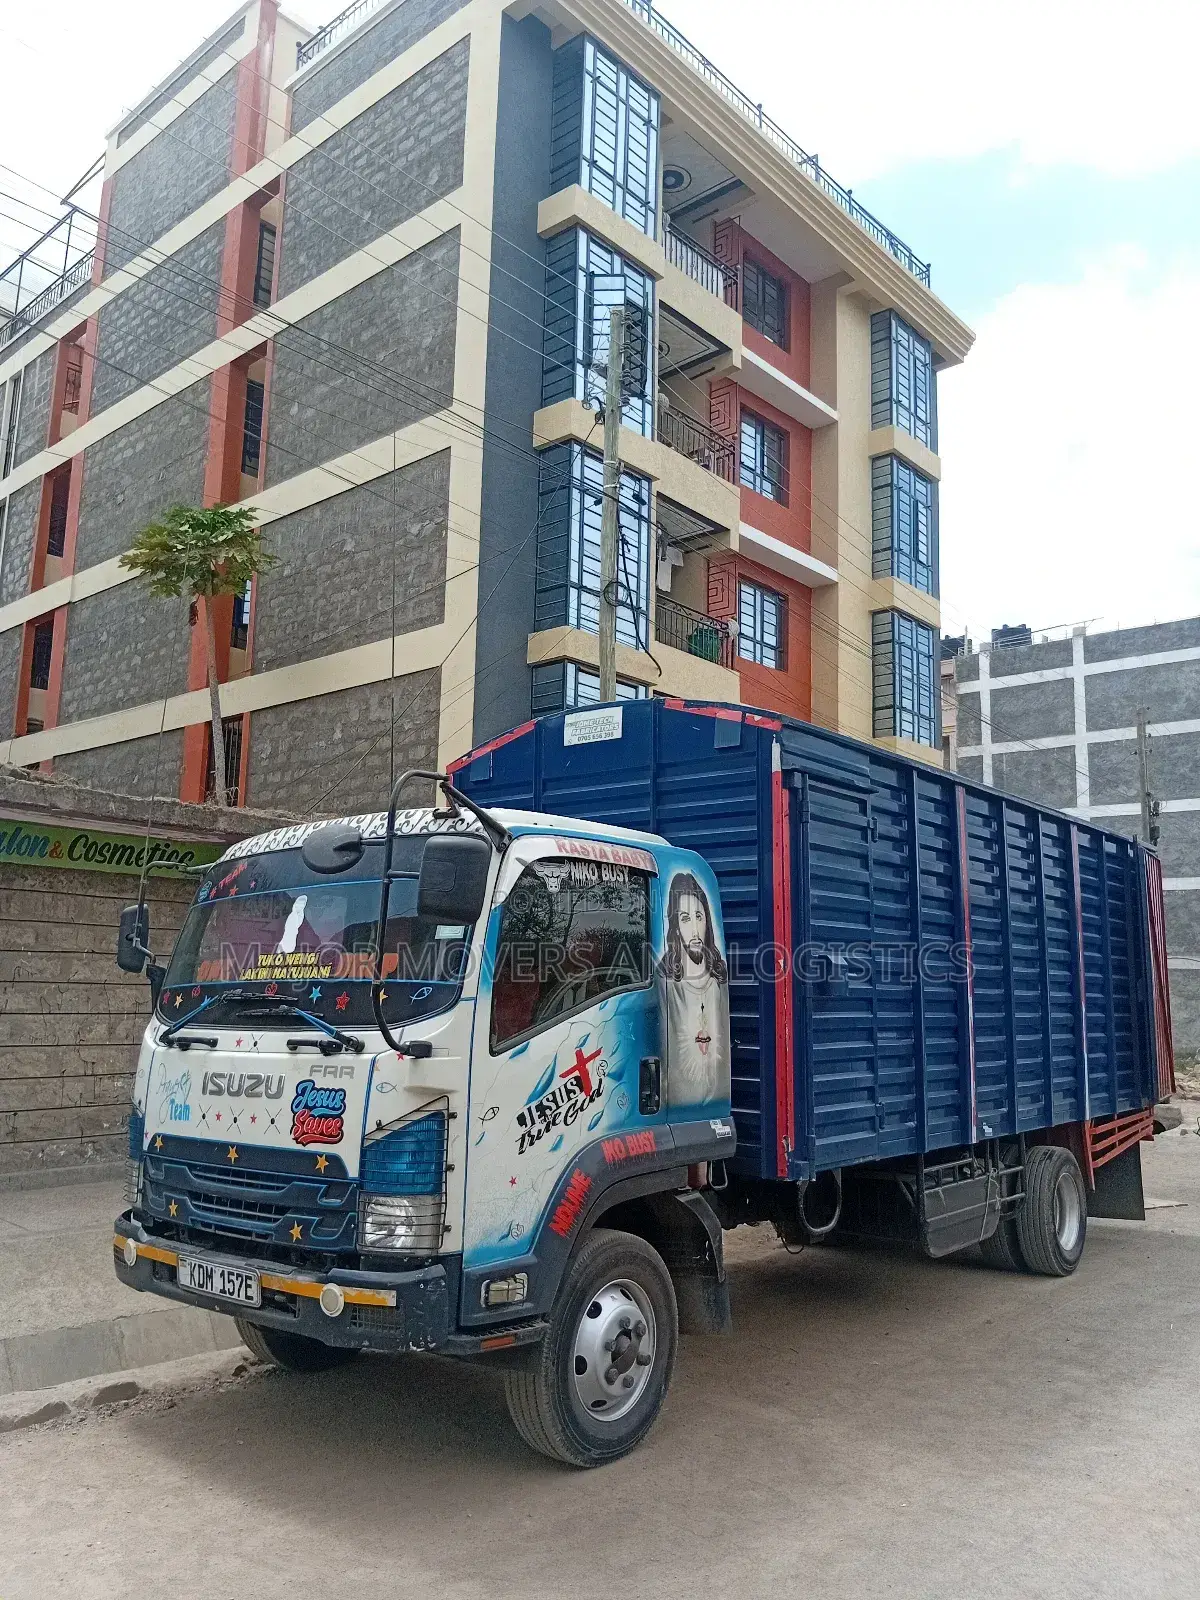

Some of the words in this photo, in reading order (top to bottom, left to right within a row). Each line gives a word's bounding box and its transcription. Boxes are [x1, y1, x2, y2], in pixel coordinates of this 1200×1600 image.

[571, 722, 620, 737] FABRICATORS
[50, 840, 64, 859] &
[570, 861, 599, 884] NIKO
[601, 863, 629, 884] BUSY
[258, 953, 283, 966] TUKO
[201, 1071, 286, 1099] ISUZU
[291, 1079, 346, 1116] Jesus
[169, 1098, 191, 1121] Team
[517, 1077, 582, 1129] JESUS
[564, 1078, 605, 1126] God
[291, 1109, 345, 1146] Saves
[625, 1131, 657, 1157] BUSY
[189, 1262, 214, 1291] KDM
[219, 1269, 254, 1301] 157E
